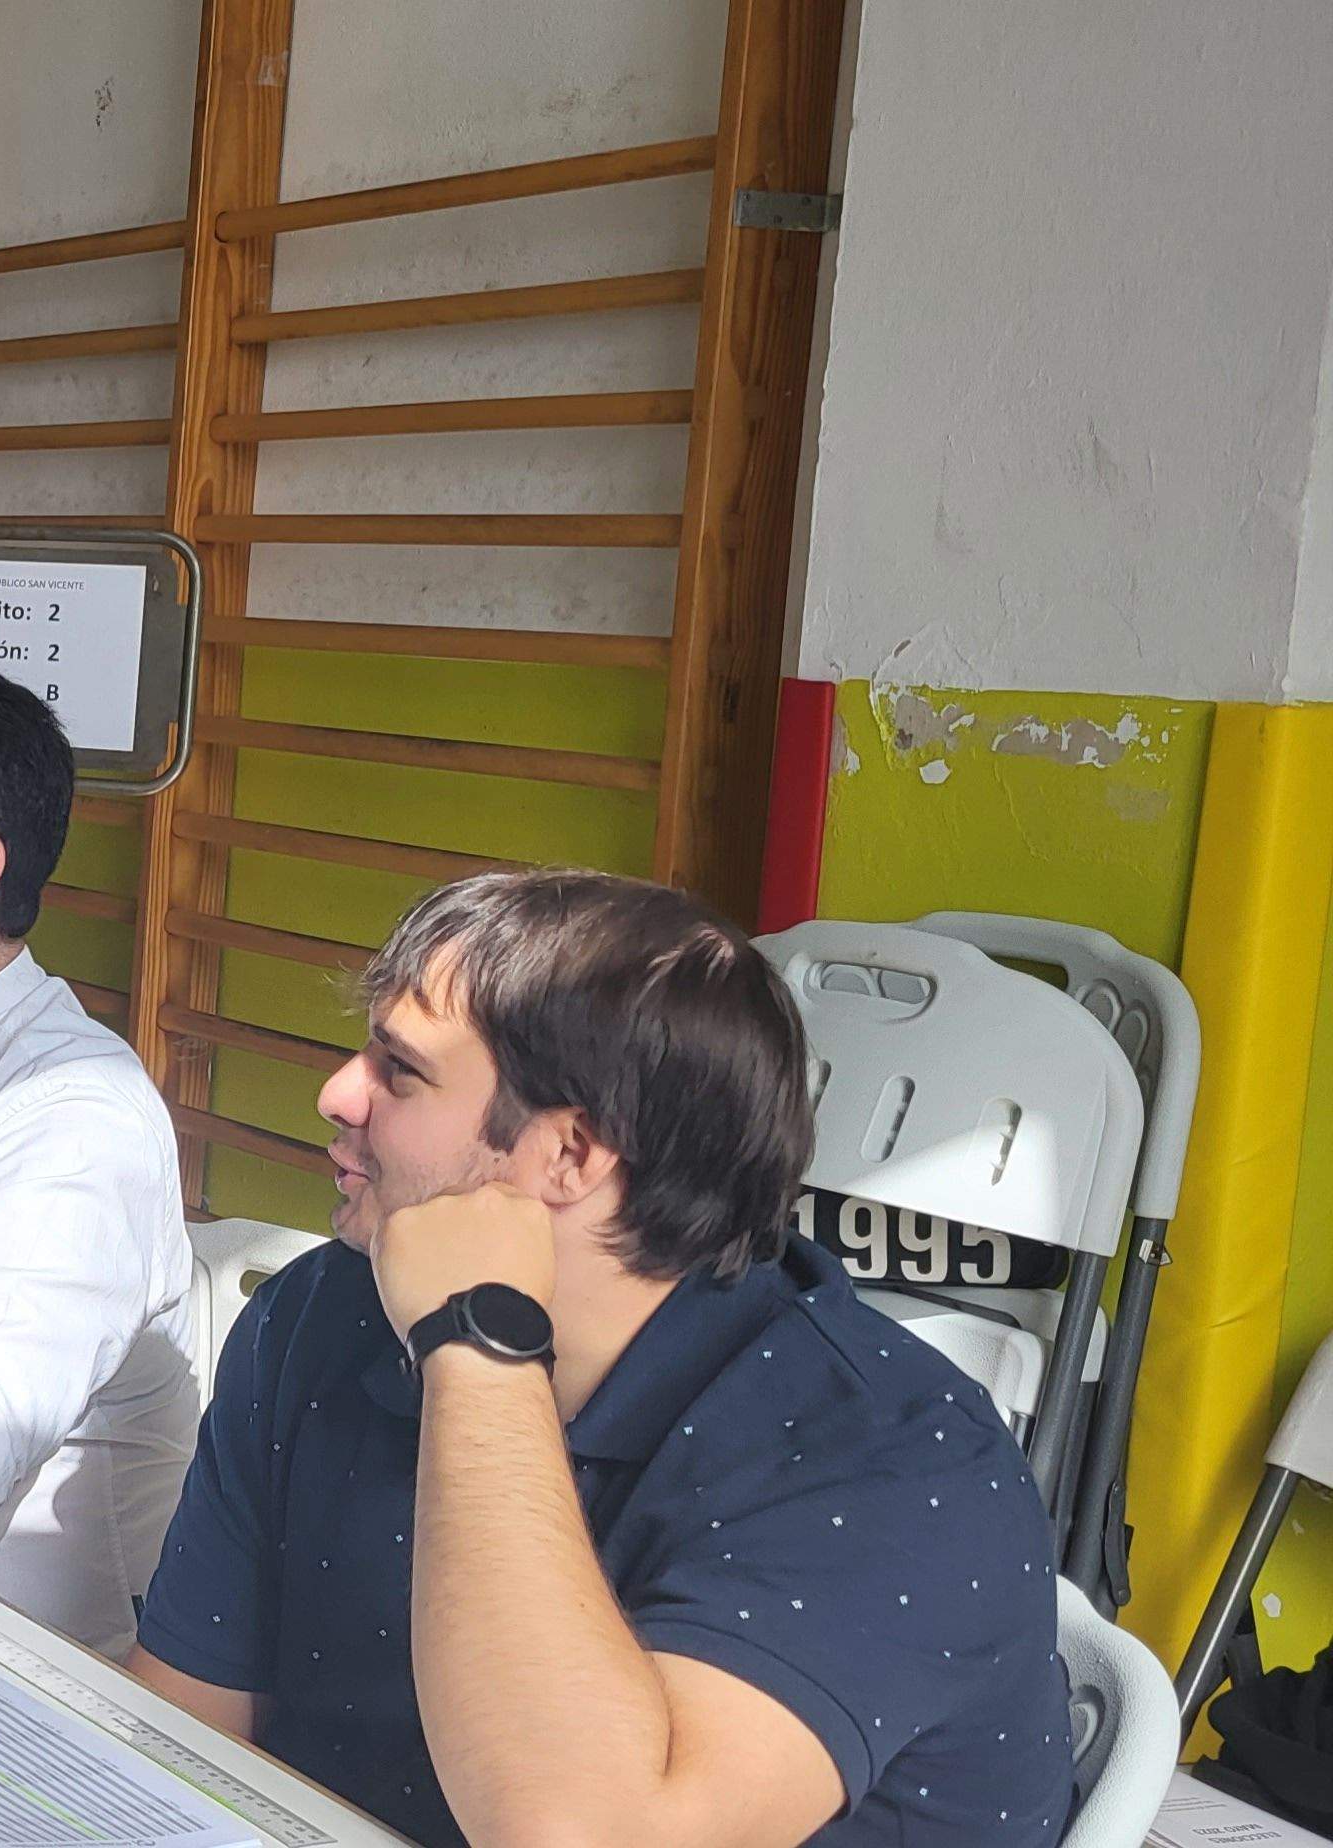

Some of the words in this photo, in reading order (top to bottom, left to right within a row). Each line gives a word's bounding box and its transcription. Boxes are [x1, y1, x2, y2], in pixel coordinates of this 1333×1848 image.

[27, 579, 46, 589] SAN
[48, 581, 84, 590] VICENTE
[48, 603, 60, 622] 2
[47, 643, 60, 662] 2
[46, 683, 60, 702] B
[790, 1193, 1012, 1285] 1995
